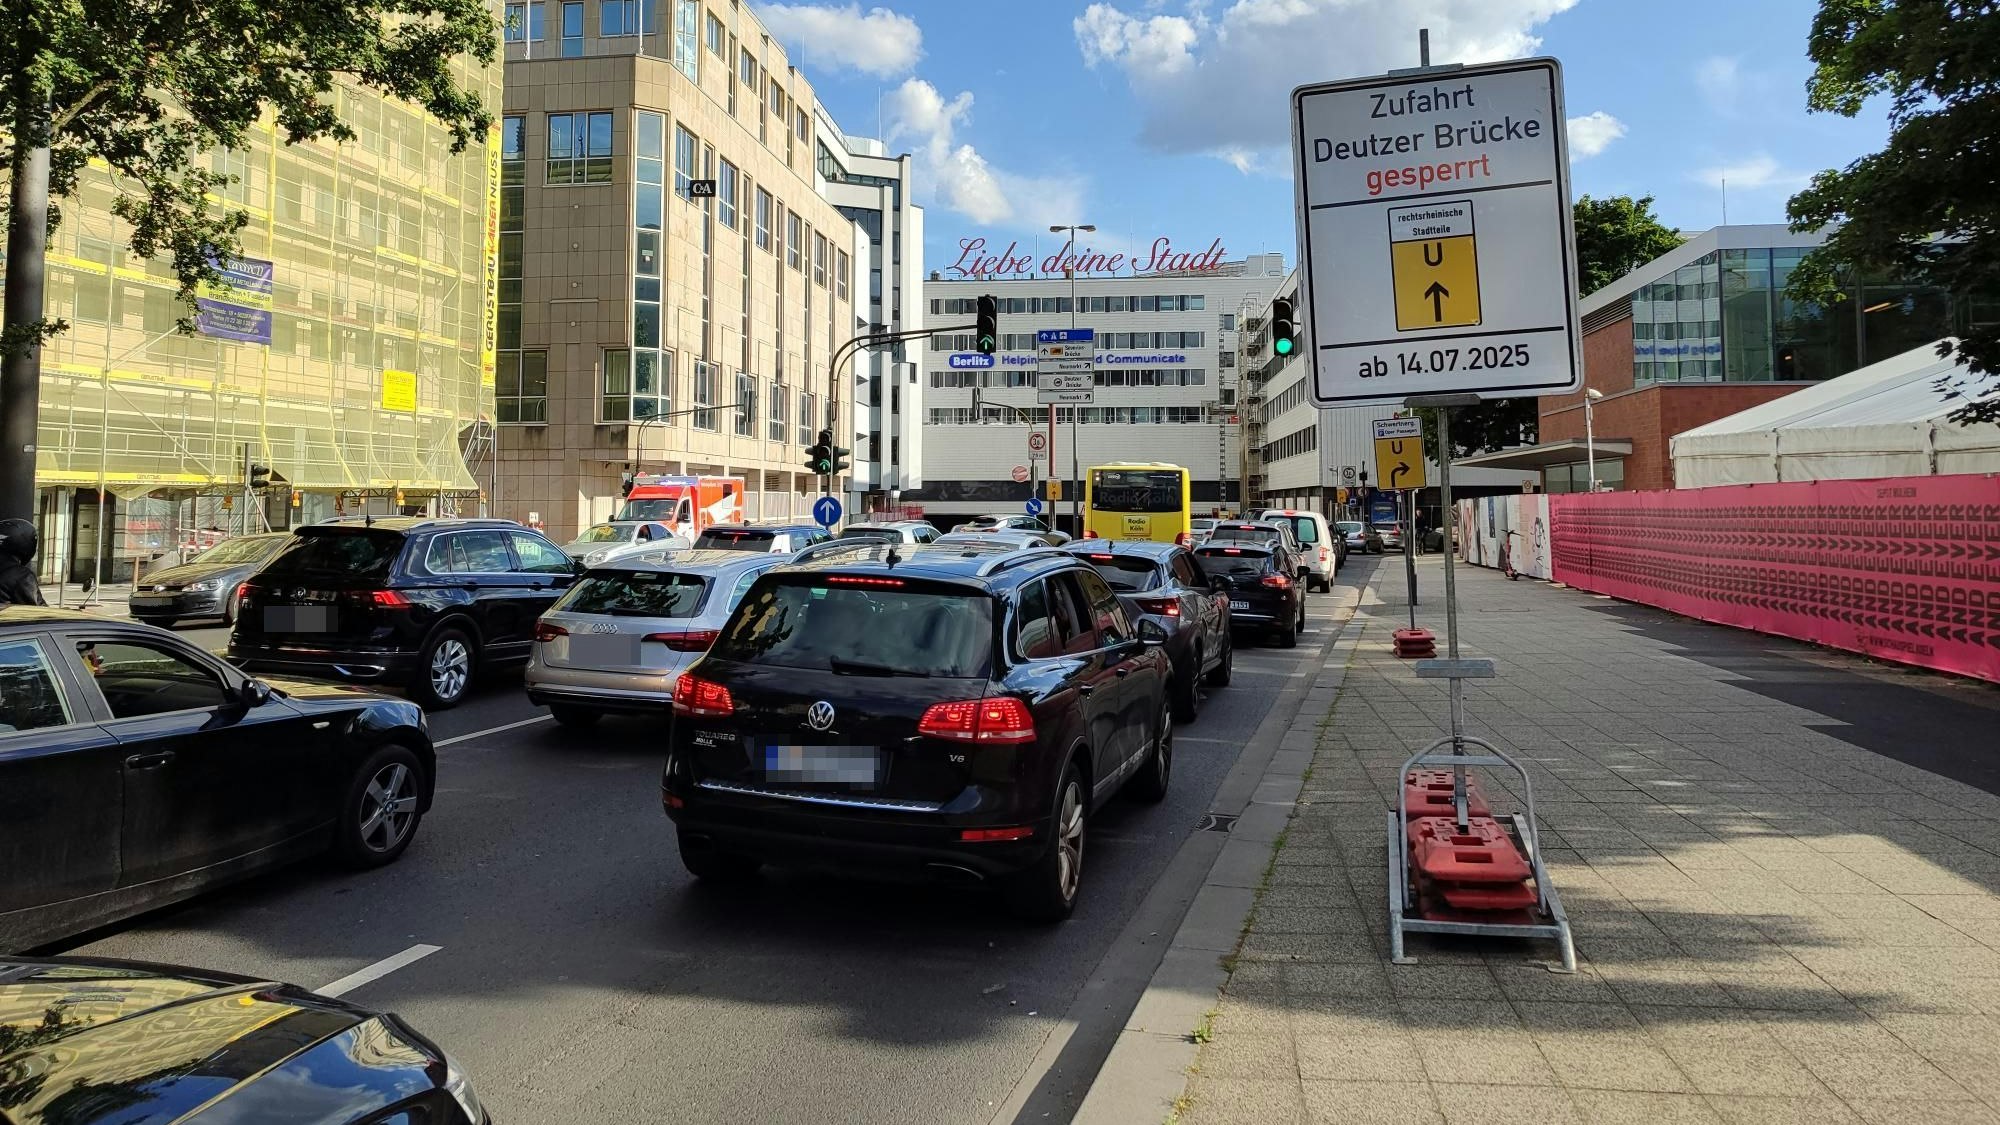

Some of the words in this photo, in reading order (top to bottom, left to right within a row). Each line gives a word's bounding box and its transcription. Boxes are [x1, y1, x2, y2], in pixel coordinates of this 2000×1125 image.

[1370, 84, 1475, 119] Zufahrt
[1313, 132, 1425, 163] Deutzer
[1434, 115, 1541, 150] Brücke
[490, 150, 498, 198] NEUSS
[1366, 154, 1491, 196] gesperrt
[1398, 208, 1463, 222] rechtsrheinische
[1412, 225, 1451, 236] Stadtteile
[947, 238, 1033, 277] Liebe
[1041, 239, 1125, 274] deine
[1131, 237, 1228, 273] Stadt
[1423, 242, 1443, 267] U
[953, 356, 990, 366] Berlitz
[1001, 355, 1037, 366] Helpin
[1106, 354, 1186, 364] Communicate
[1359, 355, 1389, 378] ab
[1397, 344, 1530, 375] 14.07.2025
[1392, 440, 1402, 454] U
